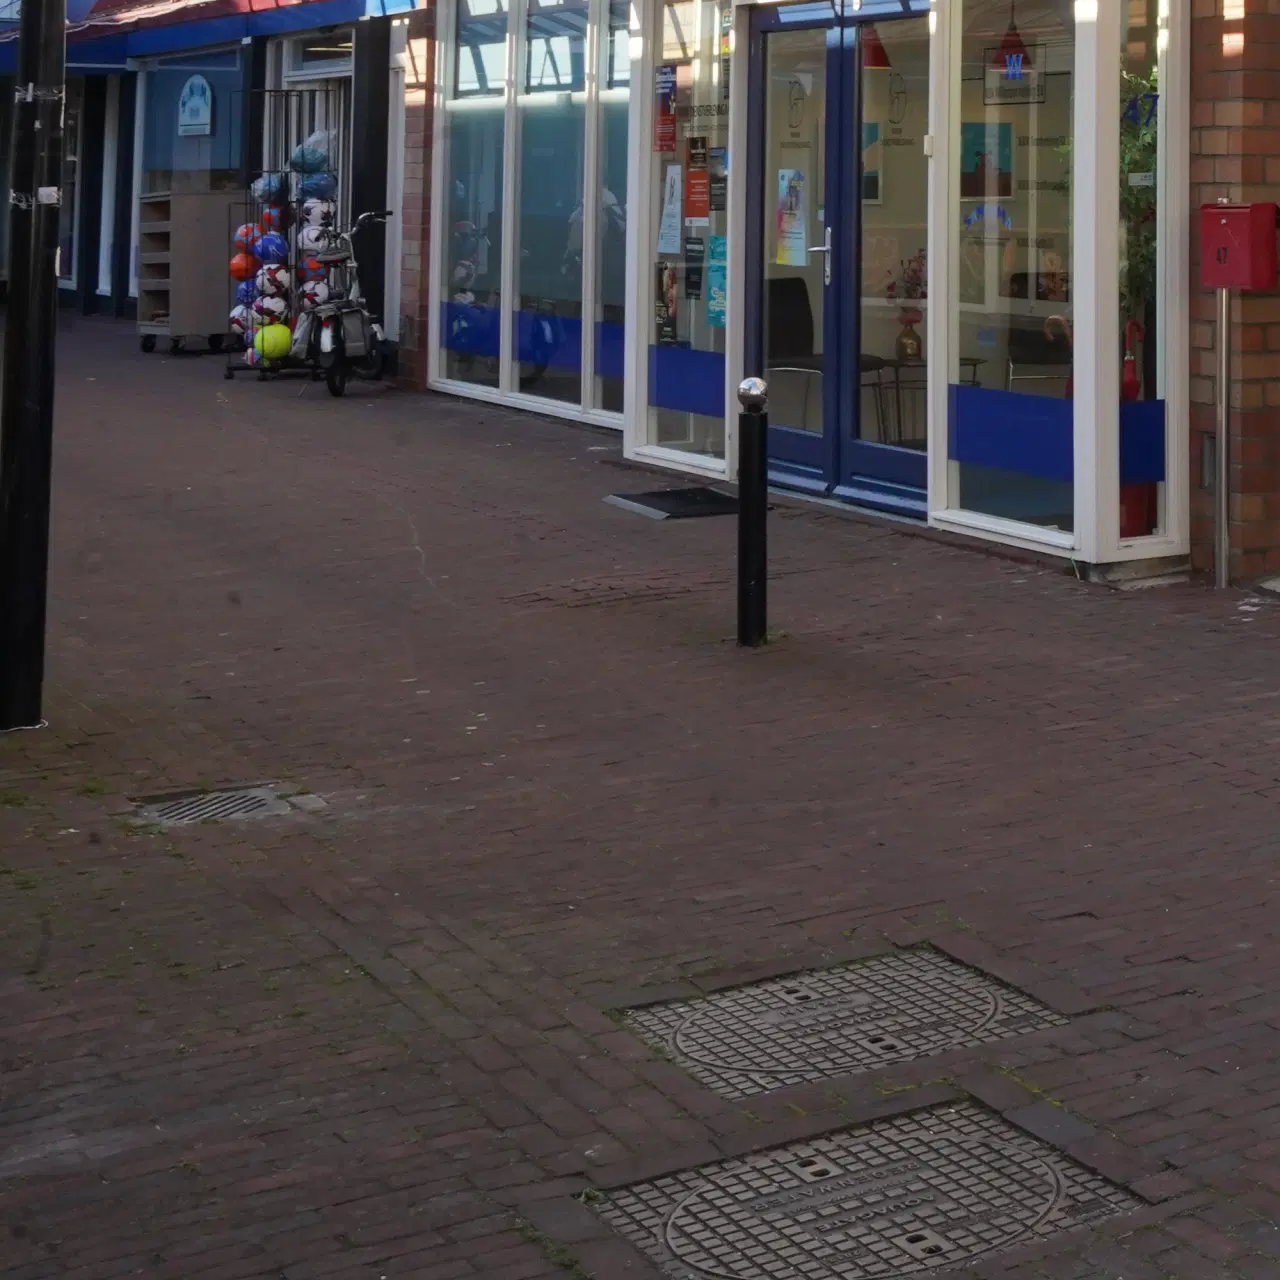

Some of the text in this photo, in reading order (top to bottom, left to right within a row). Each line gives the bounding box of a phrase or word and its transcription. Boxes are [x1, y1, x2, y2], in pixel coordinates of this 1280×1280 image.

[1123, 94, 1160, 127] 47
[749, 1161, 923, 1211] REGENWATER
[810, 1193, 938, 1232] AQUAGATE
